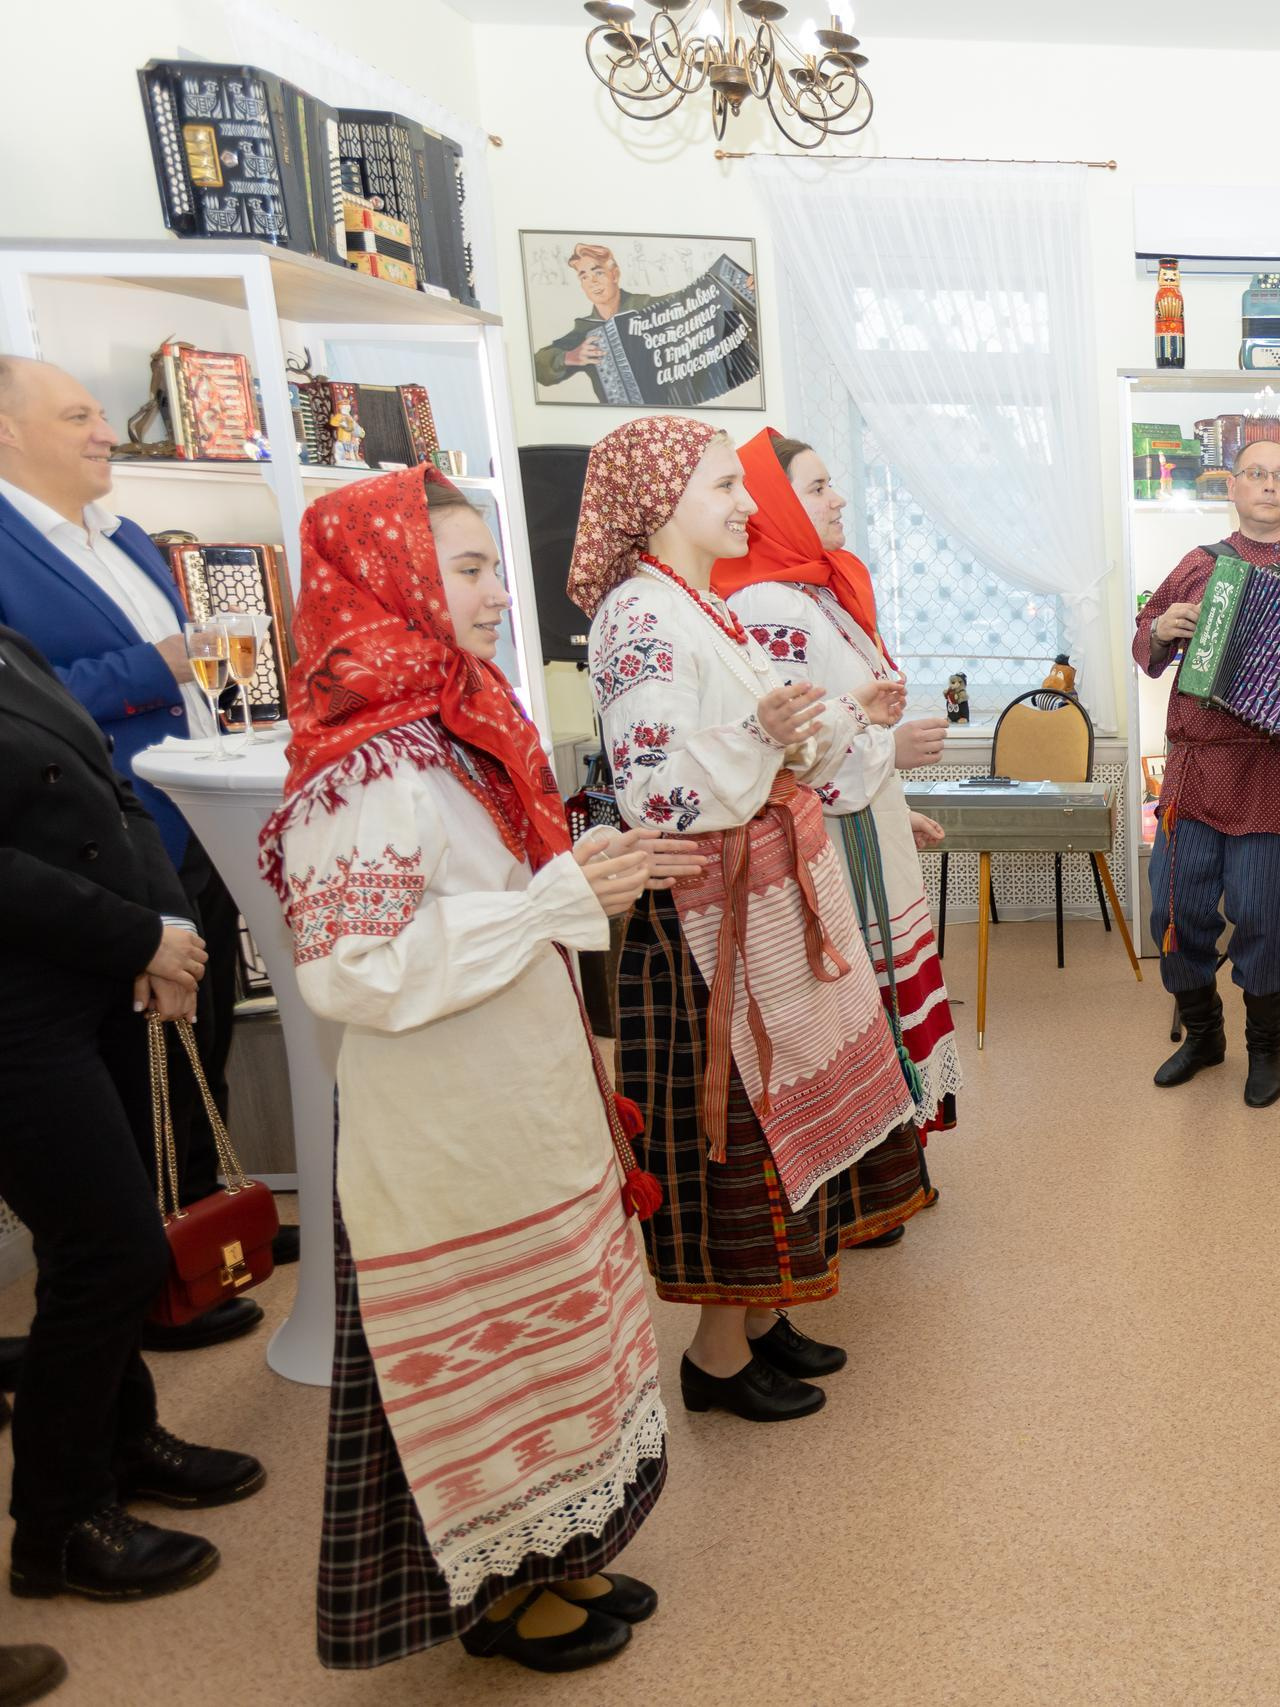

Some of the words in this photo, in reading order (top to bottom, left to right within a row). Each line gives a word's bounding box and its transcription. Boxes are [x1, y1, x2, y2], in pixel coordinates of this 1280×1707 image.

[653, 348, 663, 368] в
[664, 324, 716, 364] кружки
[1199, 606, 1217, 646] Тульская
